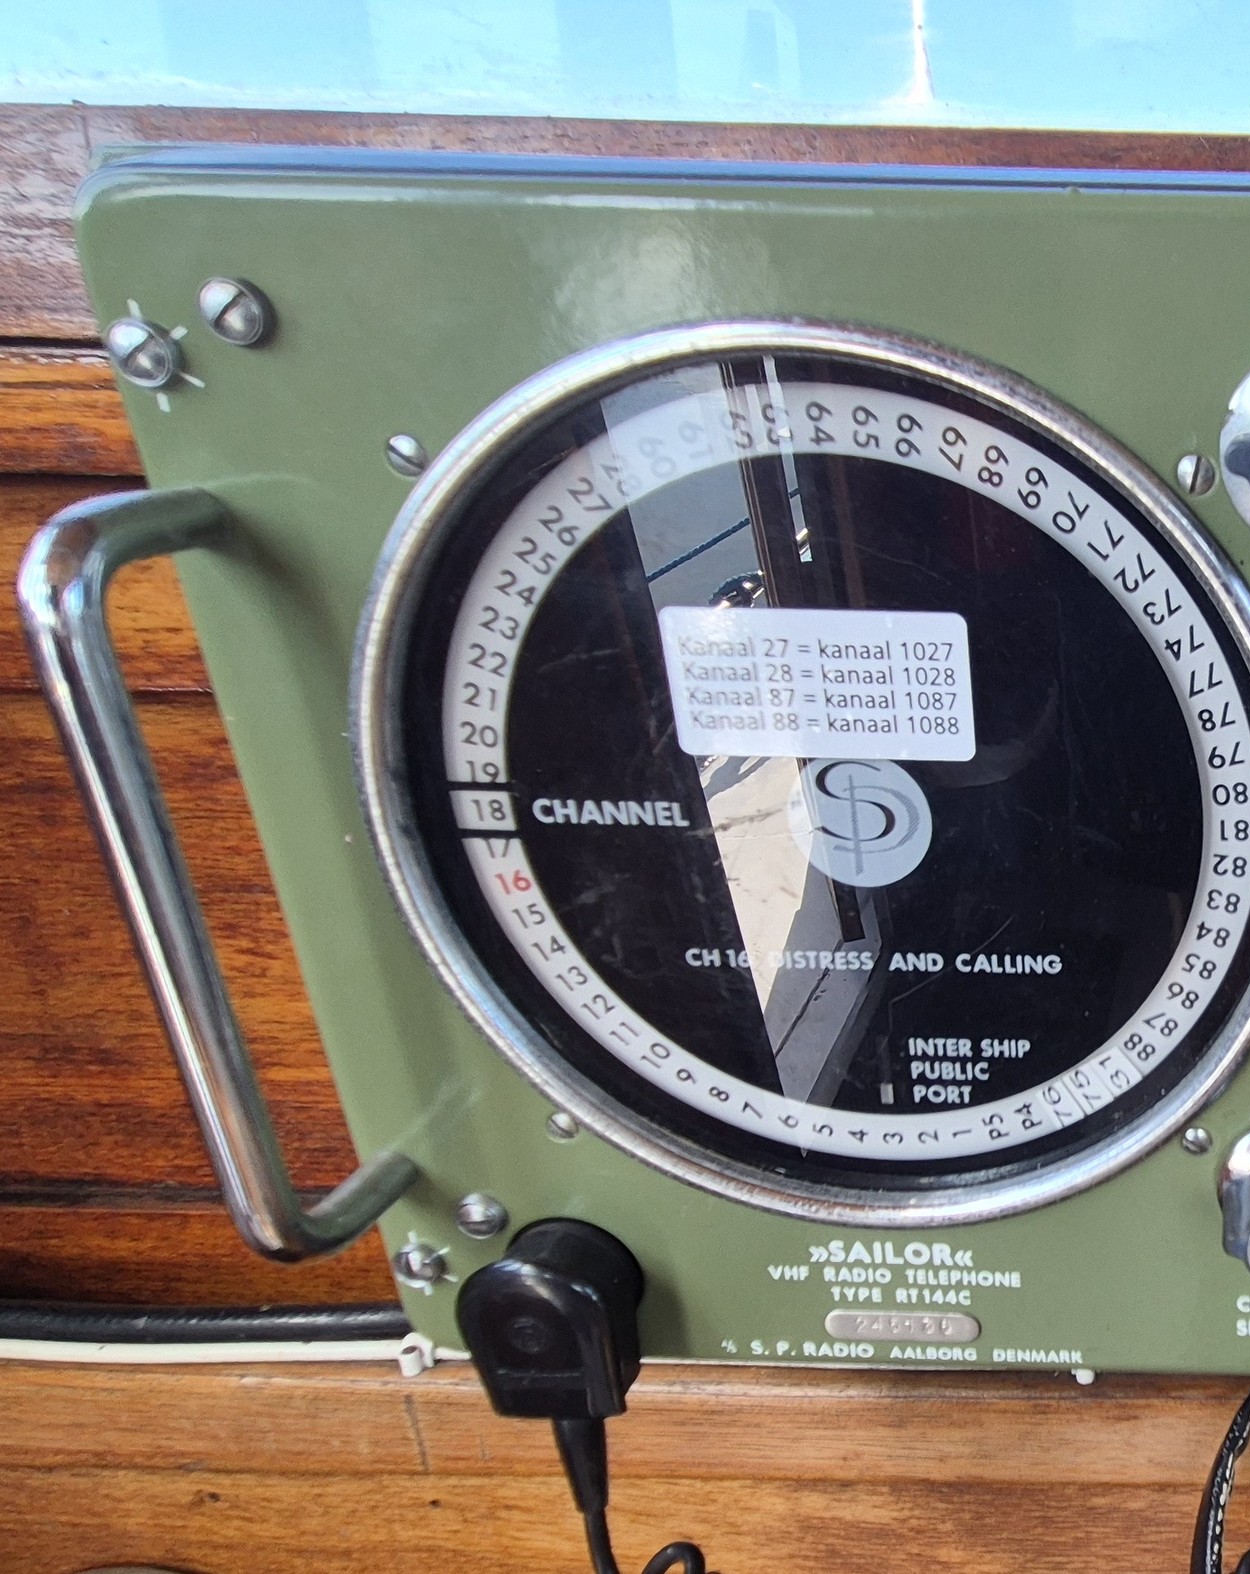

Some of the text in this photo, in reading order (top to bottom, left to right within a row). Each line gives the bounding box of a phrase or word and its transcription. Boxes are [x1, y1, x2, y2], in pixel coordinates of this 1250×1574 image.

[805, 401, 835, 447] 64
[851, 405, 880, 451] 65
[894, 413, 924, 459] 66
[938, 426, 968, 472] 67
[977, 445, 1010, 488] 68
[567, 476, 613, 513] 27
[1018, 466, 1049, 509] 69
[538, 504, 578, 547] 26
[1051, 491, 1090, 534] 70
[1087, 520, 1125, 562] 71
[513, 536, 556, 577] 25
[1113, 552, 1156, 594] 72
[494, 569, 537, 607] 24
[1142, 587, 1182, 625] 73
[478, 605, 521, 640] 23
[764, 639, 789, 658] 27
[798, 644, 811, 654] =
[818, 639, 891, 661] kanaal
[900, 641, 953, 662] 1027
[1164, 624, 1205, 660] 74
[467, 643, 508, 677] 22
[682, 661, 956, 687] Kanaal 28 = kanaal 1028
[1188, 662, 1224, 698] 77
[462, 682, 497, 711] 21
[686, 686, 957, 711] Kanaal 87 = kanaal 1087
[691, 711, 960, 735] Kanaal 88 = kanaal 1088
[1197, 701, 1237, 732] 78
[460, 721, 498, 748] 20
[1207, 741, 1246, 769] 79
[466, 760, 500, 783] 19
[1212, 782, 1249, 806] 80
[470, 799, 506, 821] 18
[532, 798, 690, 827] CHANNEL
[1220, 819, 1250, 842] 81
[1213, 853, 1248, 878] 82
[495, 869, 532, 895] 16
[1206, 888, 1241, 914] 83
[512, 903, 545, 929] 15
[531, 935, 566, 961] 14
[1196, 921, 1231, 948] 84
[684, 948, 1063, 975] CH 16 DISTRESS AND CALLING
[1183, 952, 1217, 980] 85
[555, 965, 588, 991] 13
[580, 994, 616, 1020] 12
[1167, 981, 1200, 1010] 86
[609, 1021, 640, 1046] 11
[1143, 1010, 1179, 1037] 87
[640, 1042, 671, 1069] 10
[908, 1037, 1031, 1059] INTER SHIP
[1123, 1032, 1156, 1063] 88
[676, 1068, 697, 1085] 9
[910, 1060, 990, 1081] PUBLIC
[708, 1086, 730, 1102] 8
[913, 1084, 972, 1105] PORT
[742, 1101, 763, 1119] 7
[777, 1114, 799, 1129] 6
[1014, 1102, 1043, 1131] P4
[813, 1123, 834, 1138] 5
[847, 1129, 869, 1144] 4
[883, 1131, 904, 1146] 3
[918, 1129, 940, 1144] 2
[952, 1128, 973, 1139] 1
[982, 1112, 1010, 1141] P5
[767, 1265, 1022, 1288] VHF RADIO TELEPHONE
[831, 1286, 882, 1304] TYPE
[803, 1342, 875, 1359] RADIO
[889, 1345, 977, 1362] AALBORG
[993, 1348, 1083, 1364] DENMARK
